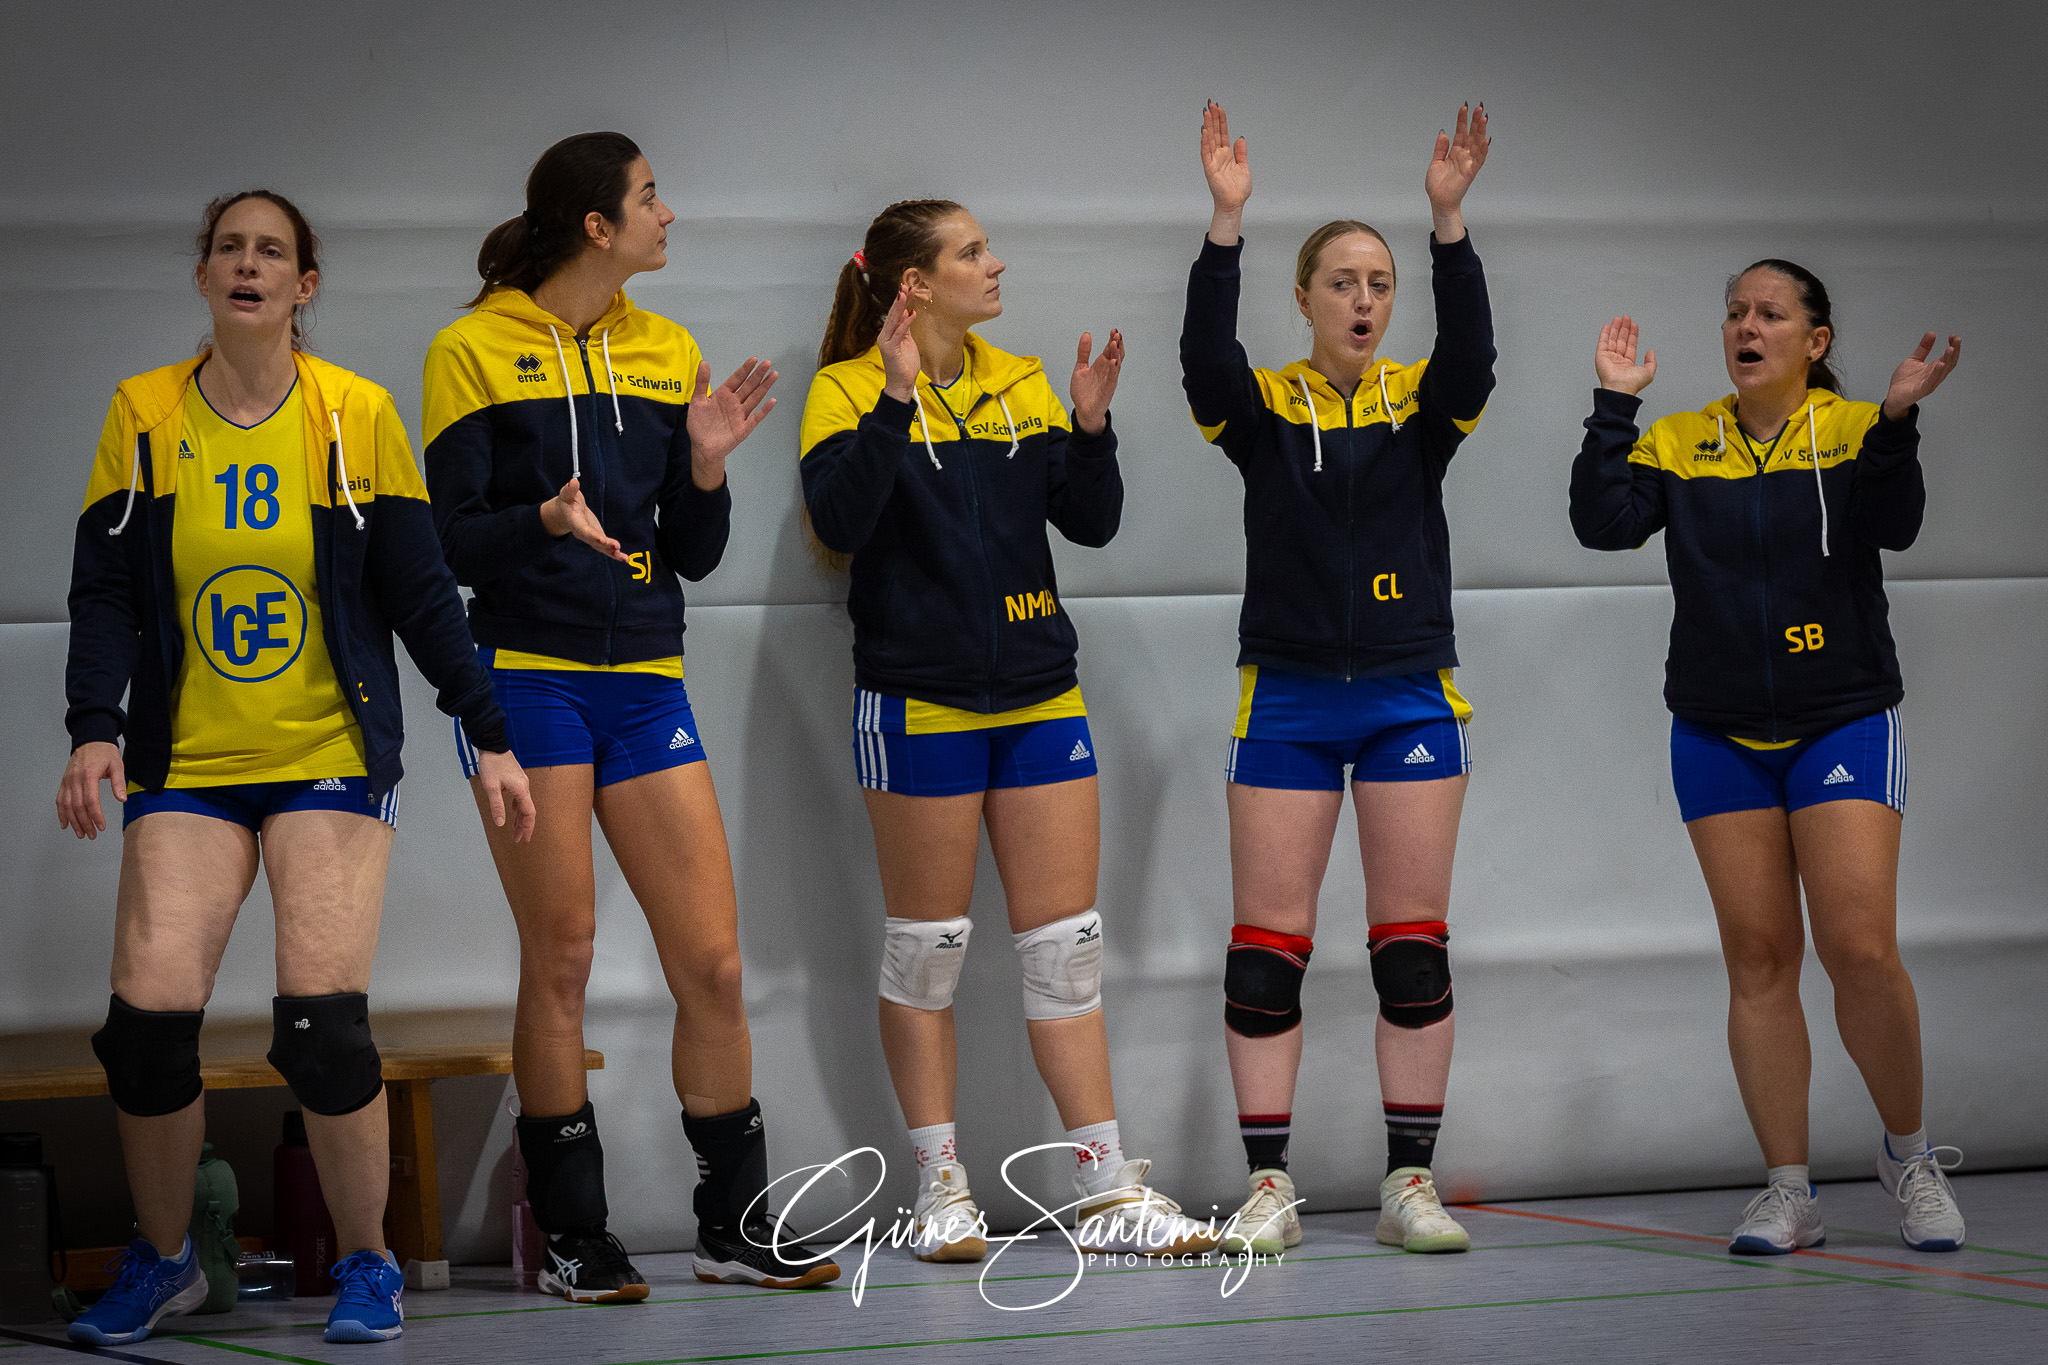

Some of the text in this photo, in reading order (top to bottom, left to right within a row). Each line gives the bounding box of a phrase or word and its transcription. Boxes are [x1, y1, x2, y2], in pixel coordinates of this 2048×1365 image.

[517, 373, 548, 383] errea
[627, 375, 682, 393] Schwaig
[1290, 396, 1309, 407] erre
[1362, 402, 1379, 417] SV
[971, 423, 989, 435] SV
[1692, 454, 1722, 462] errea
[215, 464, 280, 530] 18
[628, 551, 652, 584] SJ
[1373, 573, 1403, 601] CL
[1005, 589, 1056, 622] NMH
[210, 591, 289, 666] IGE
[1785, 623, 1825, 653] SB
[669, 737, 695, 750] adidas
[1403, 755, 1435, 764] adidas
[313, 782, 347, 791] adidas
[1823, 774, 1854, 785] adidas
